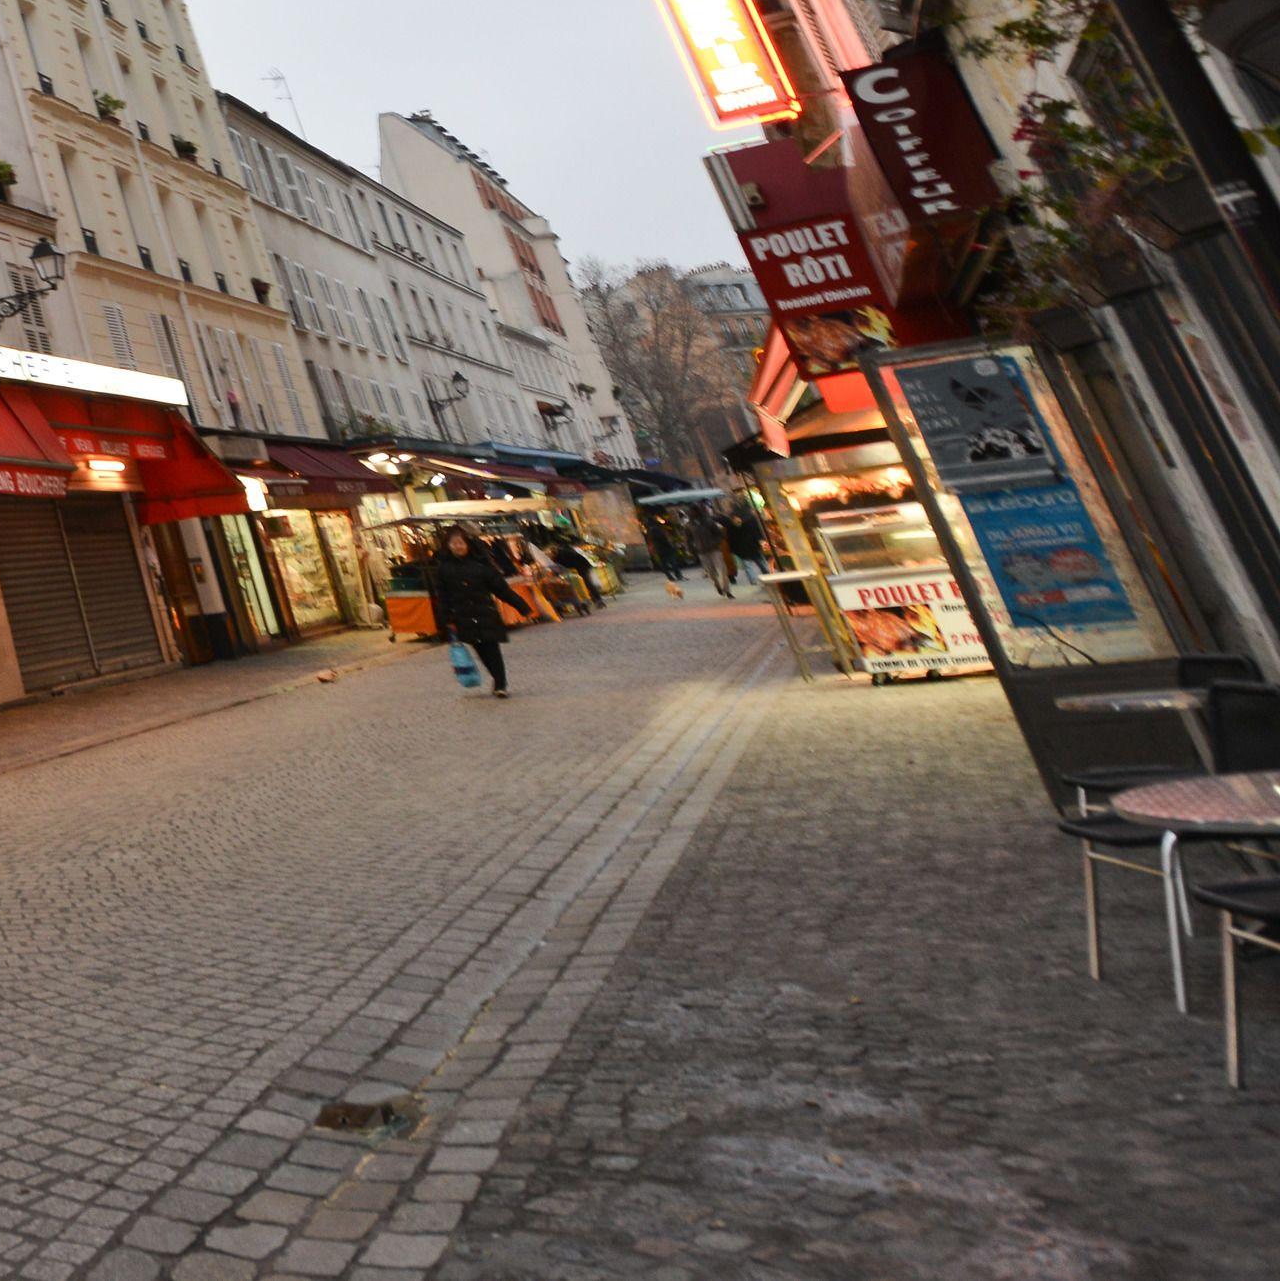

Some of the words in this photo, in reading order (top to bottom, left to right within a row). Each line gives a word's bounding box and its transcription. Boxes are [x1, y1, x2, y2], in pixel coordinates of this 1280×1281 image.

[749, 221, 850, 262] POULET
[782, 254, 853, 289] RÔTI
[856, 582, 945, 608] POULET
